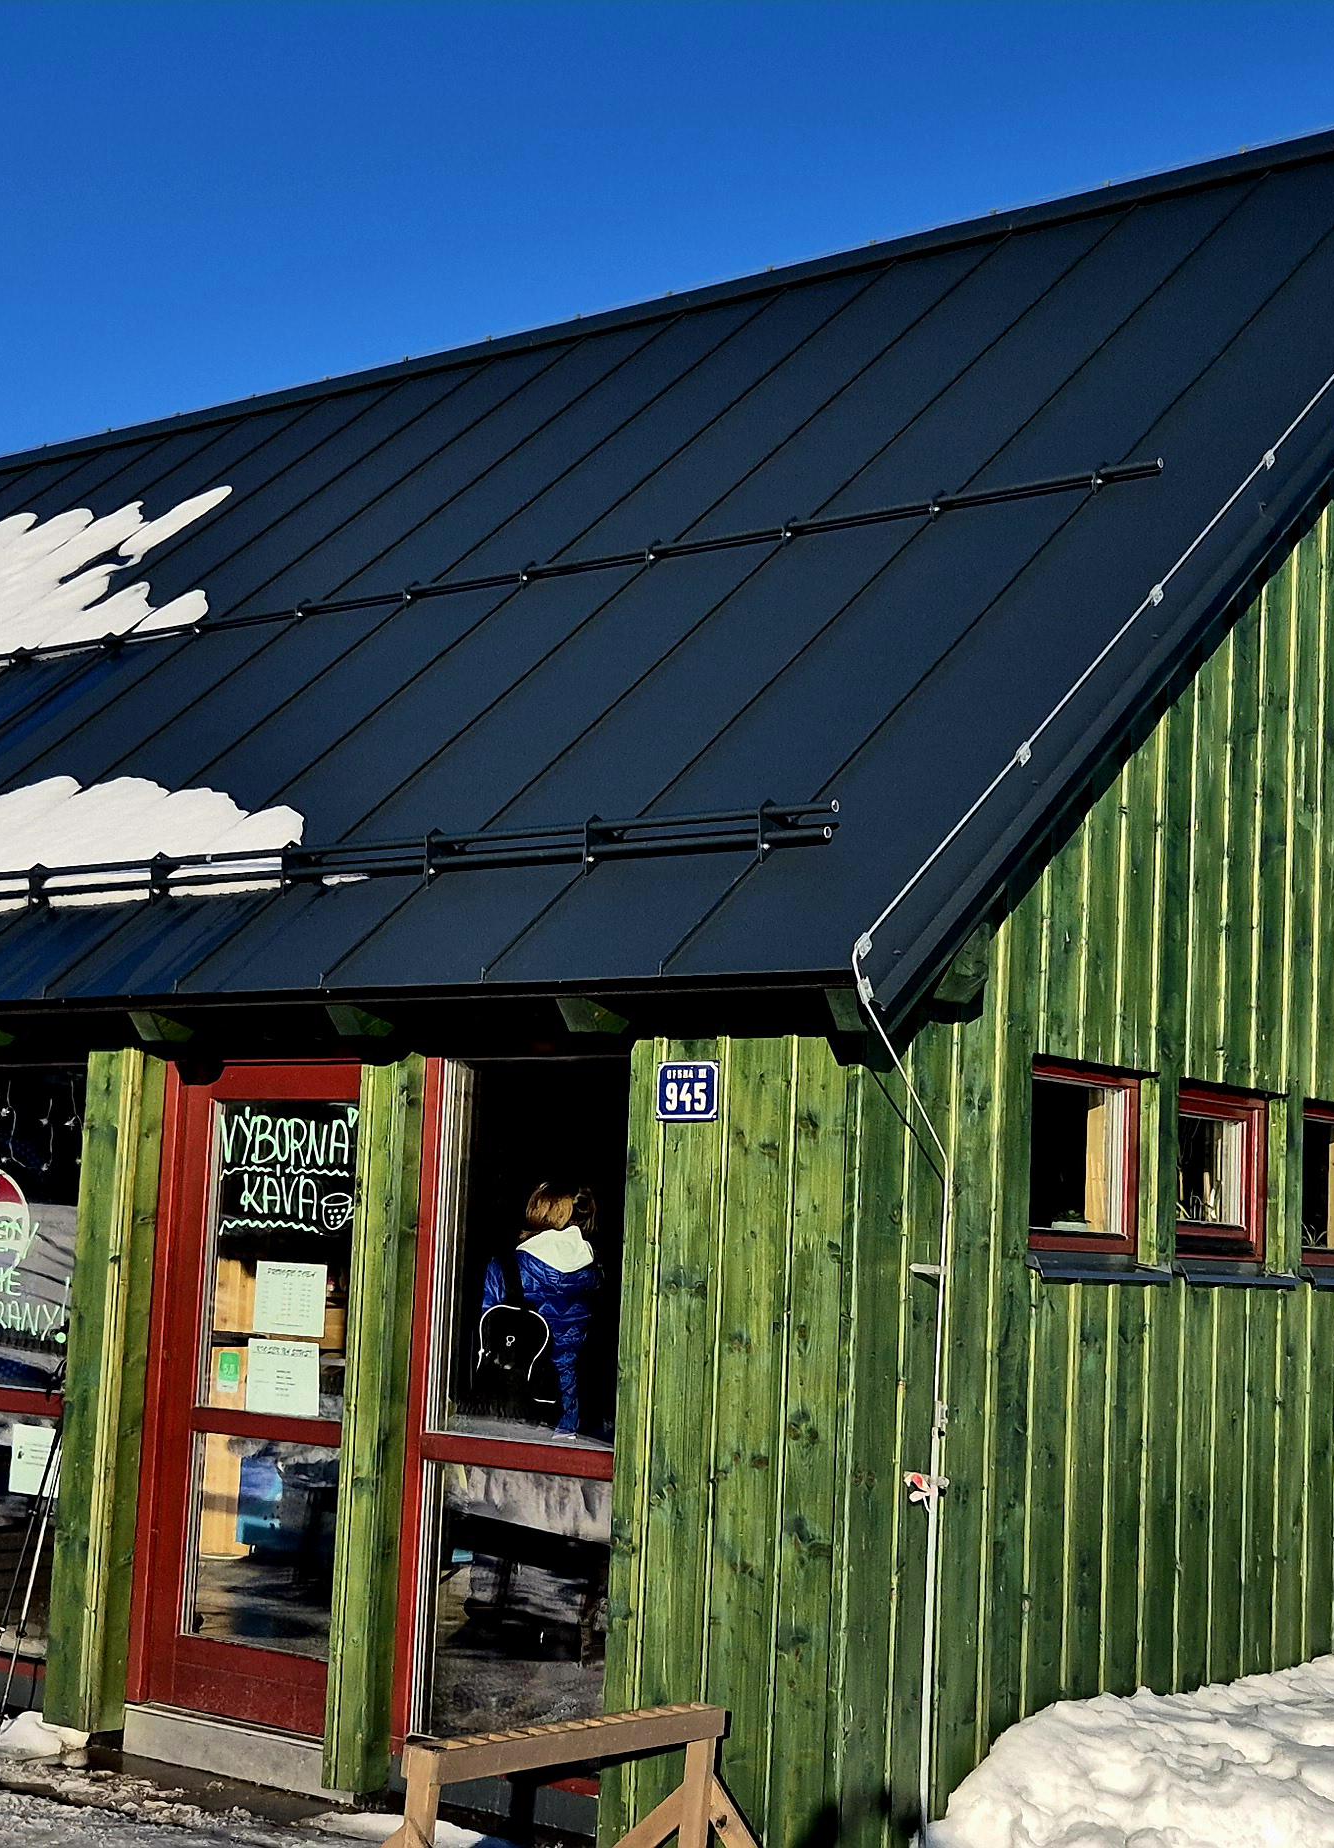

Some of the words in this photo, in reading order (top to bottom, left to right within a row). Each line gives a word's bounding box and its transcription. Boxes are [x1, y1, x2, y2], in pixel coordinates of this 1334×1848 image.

[665, 1082, 707, 1112] 945
[220, 1106, 359, 1167] VÝBORNÁ
[240, 1164, 318, 1221] KÁVA
